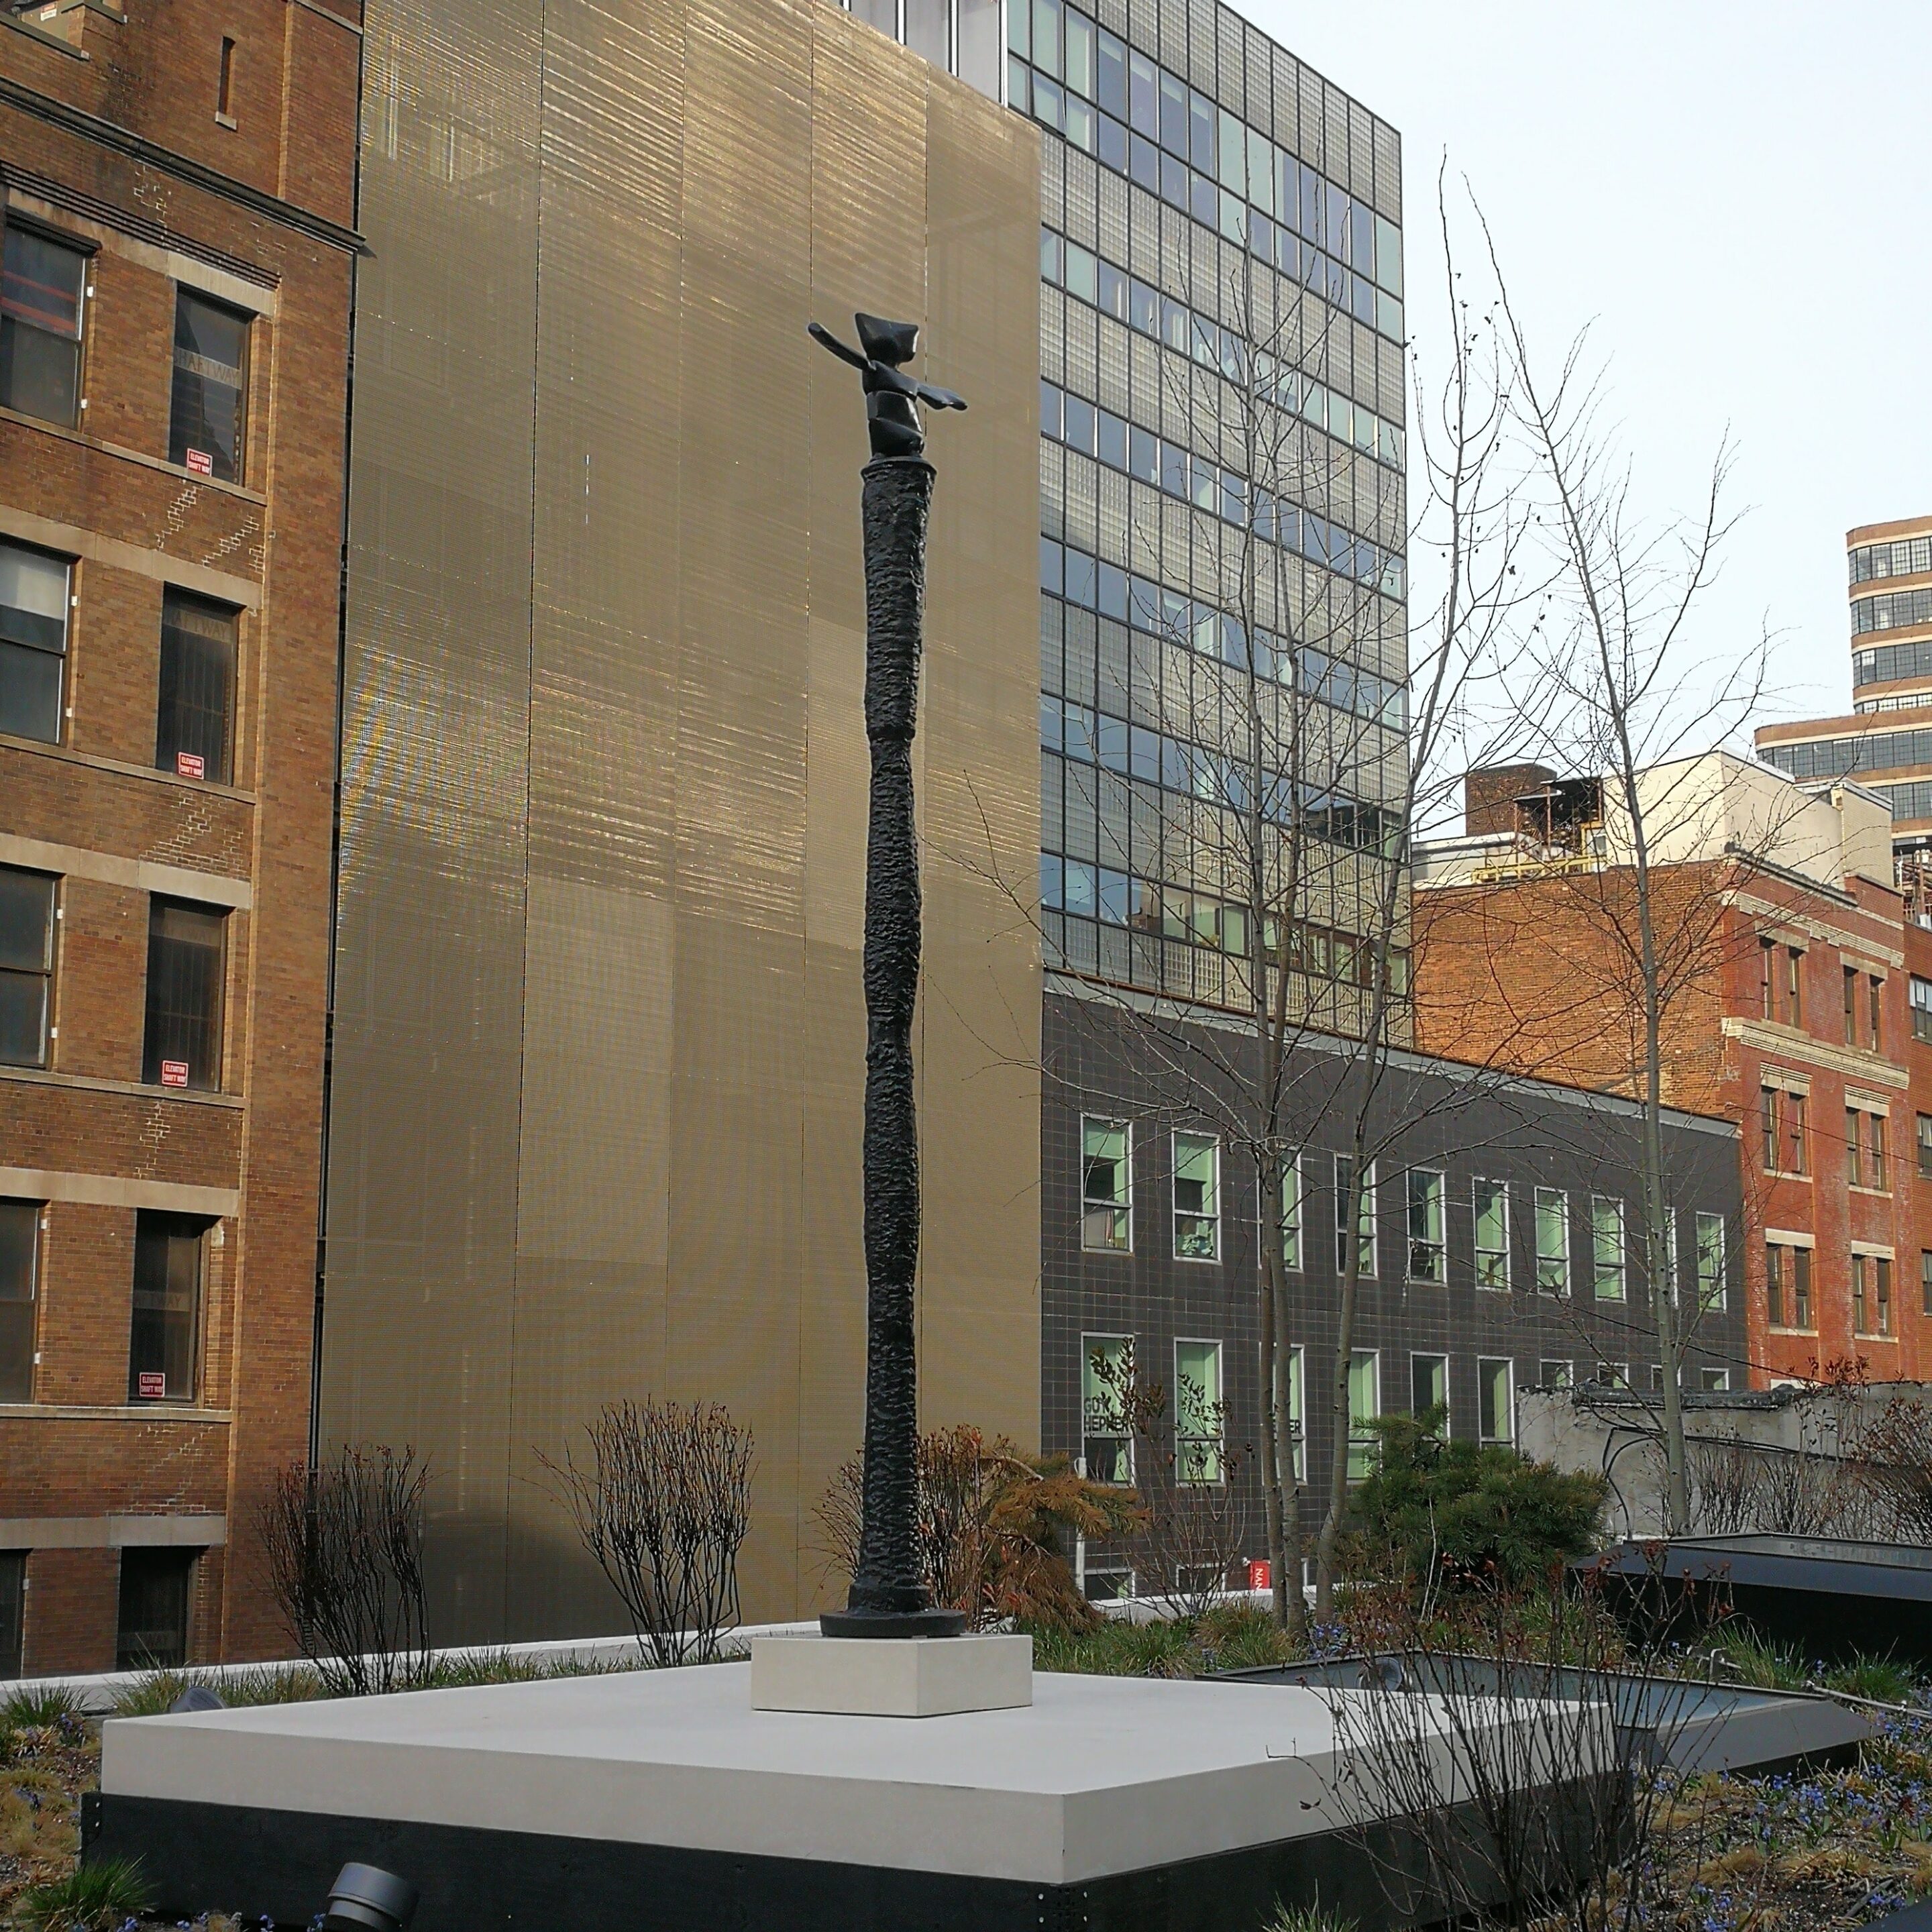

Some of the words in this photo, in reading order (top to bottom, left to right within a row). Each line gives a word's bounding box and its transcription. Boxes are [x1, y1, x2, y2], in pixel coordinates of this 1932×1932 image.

[191, 453, 209, 464] ELEVATOR
[181, 757, 201, 767] ELEVATOR
[165, 1064, 185, 1073] ELEVATOR
